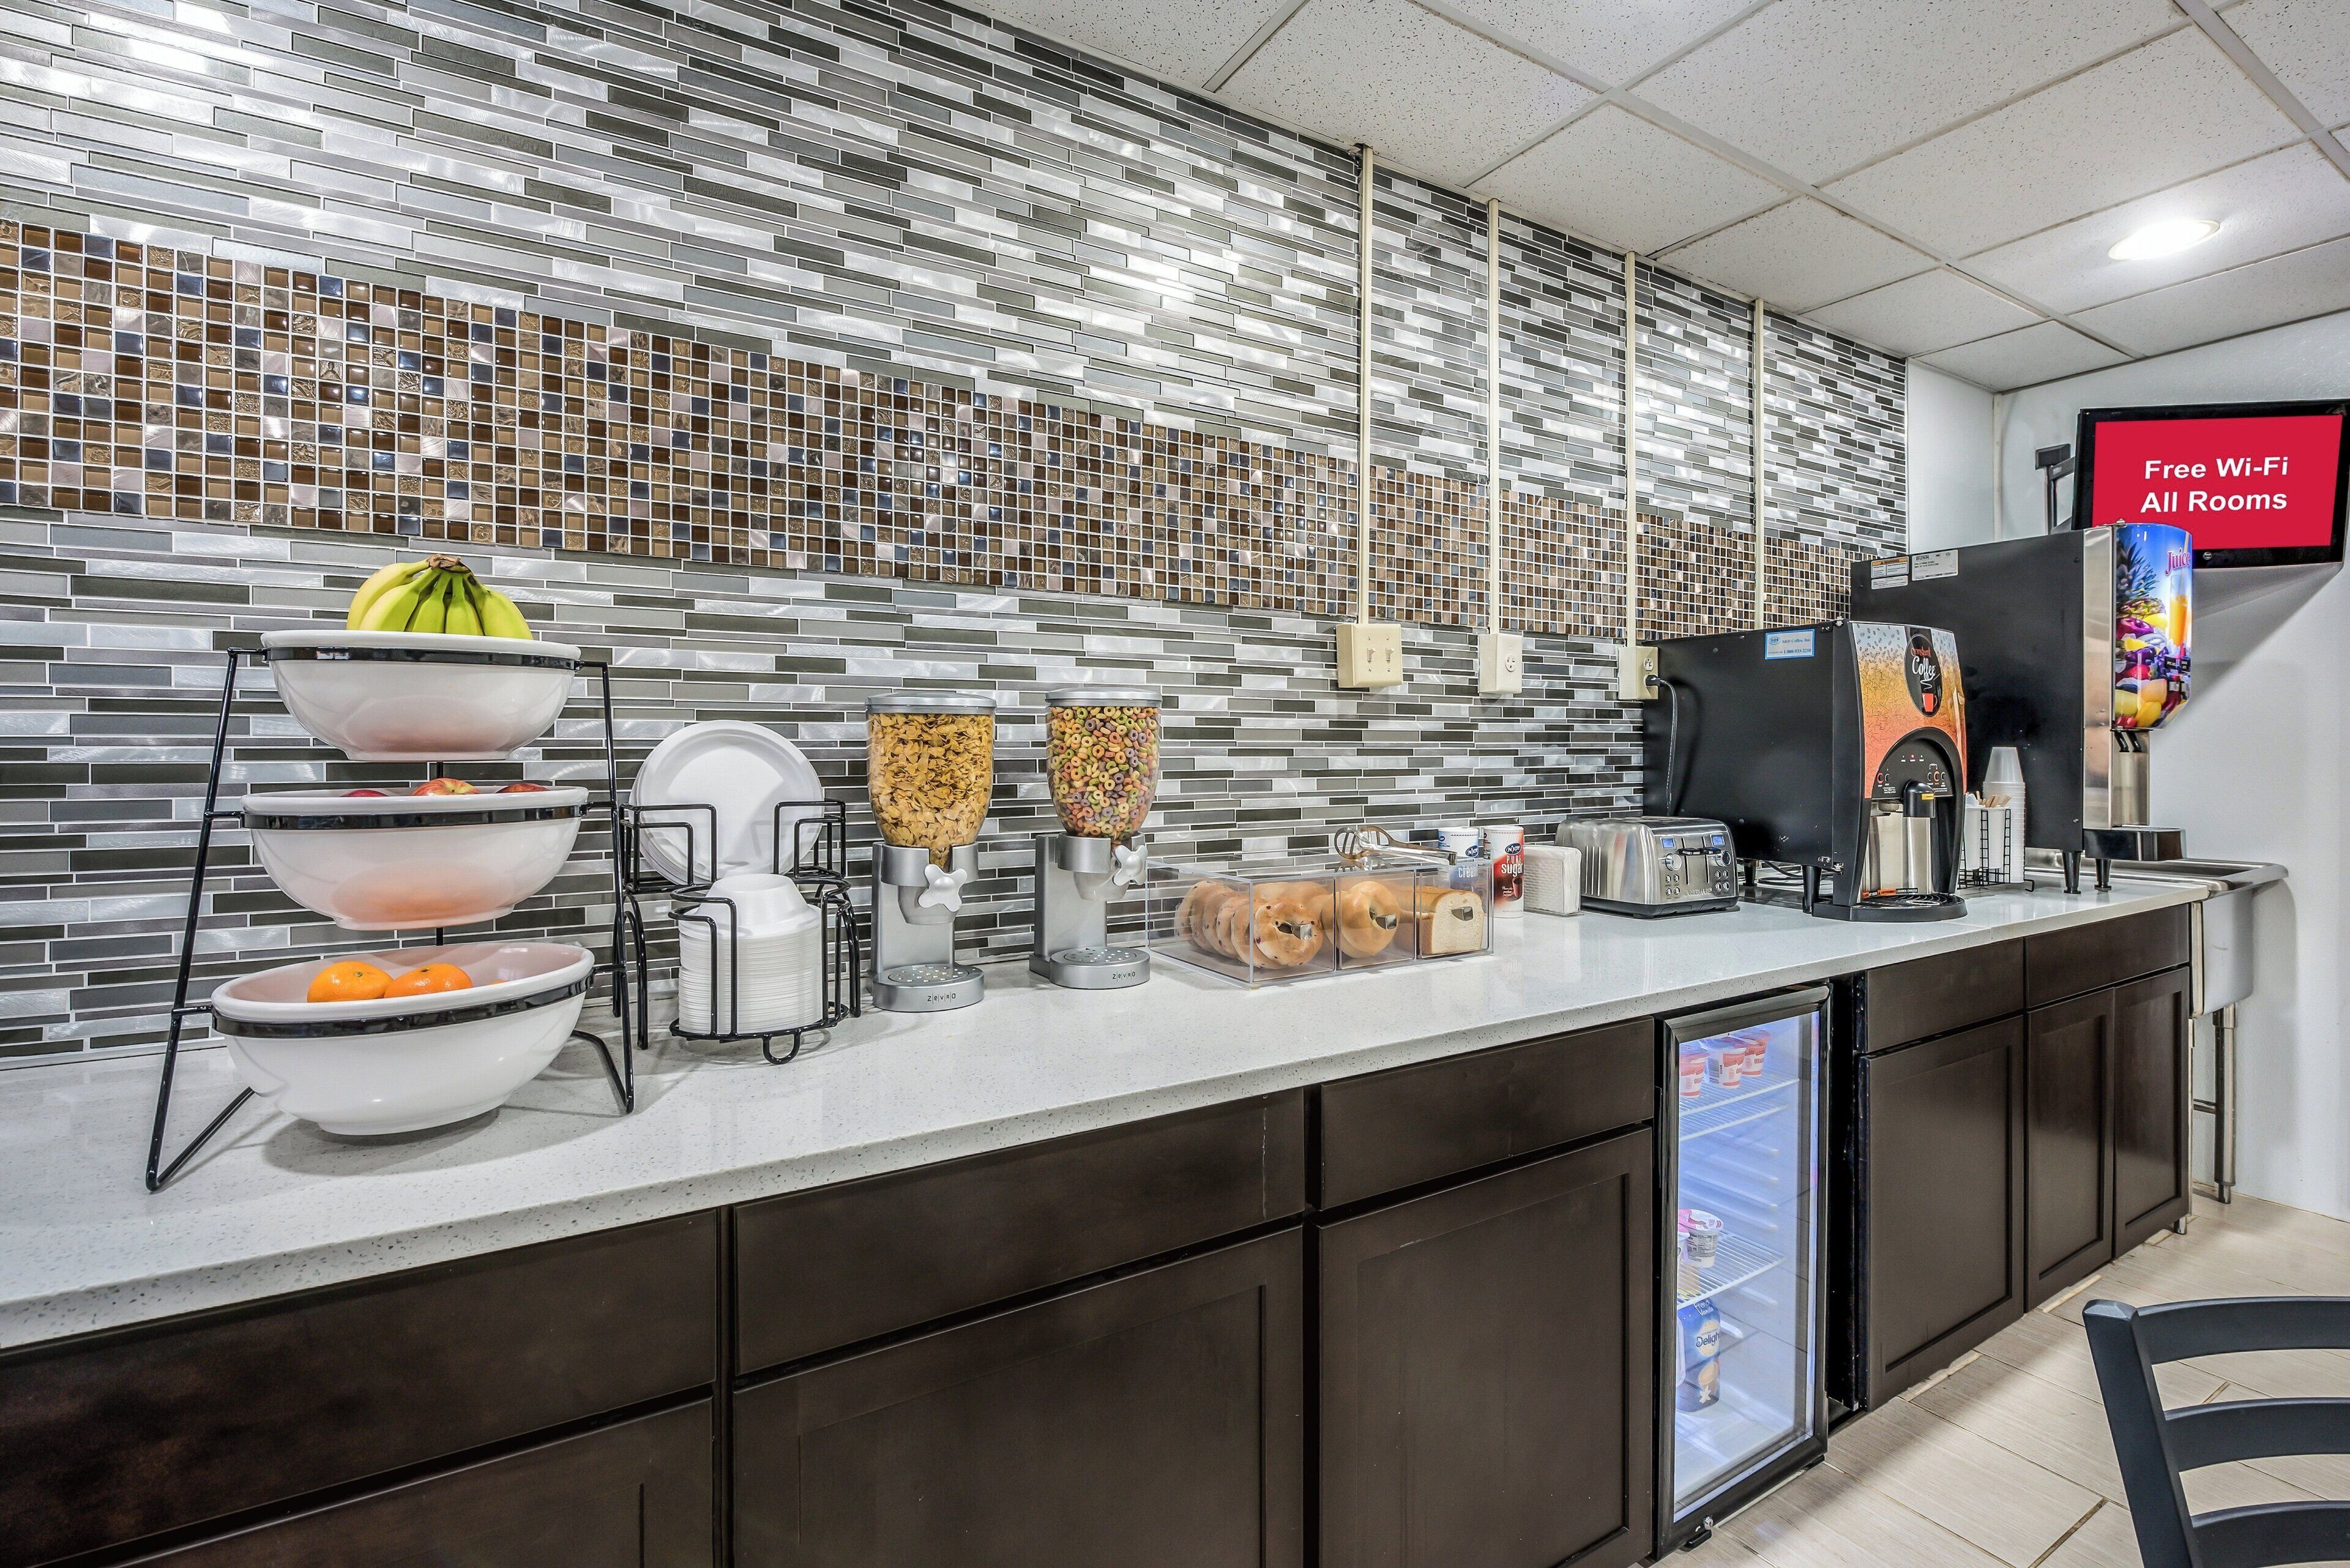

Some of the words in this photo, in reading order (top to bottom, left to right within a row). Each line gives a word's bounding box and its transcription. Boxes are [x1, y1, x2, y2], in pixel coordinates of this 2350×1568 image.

[2145, 460, 2206, 479] Free
[2216, 457, 2288, 477] Wi-Fi
[2140, 491, 2177, 513] All
[2188, 491, 2288, 512] Rooms
[2166, 548, 2190, 575] Juice
[1912, 656, 1936, 680] Coffee
[1501, 863, 1523, 877] sugar
[1696, 1332, 1720, 1347] Deligh
